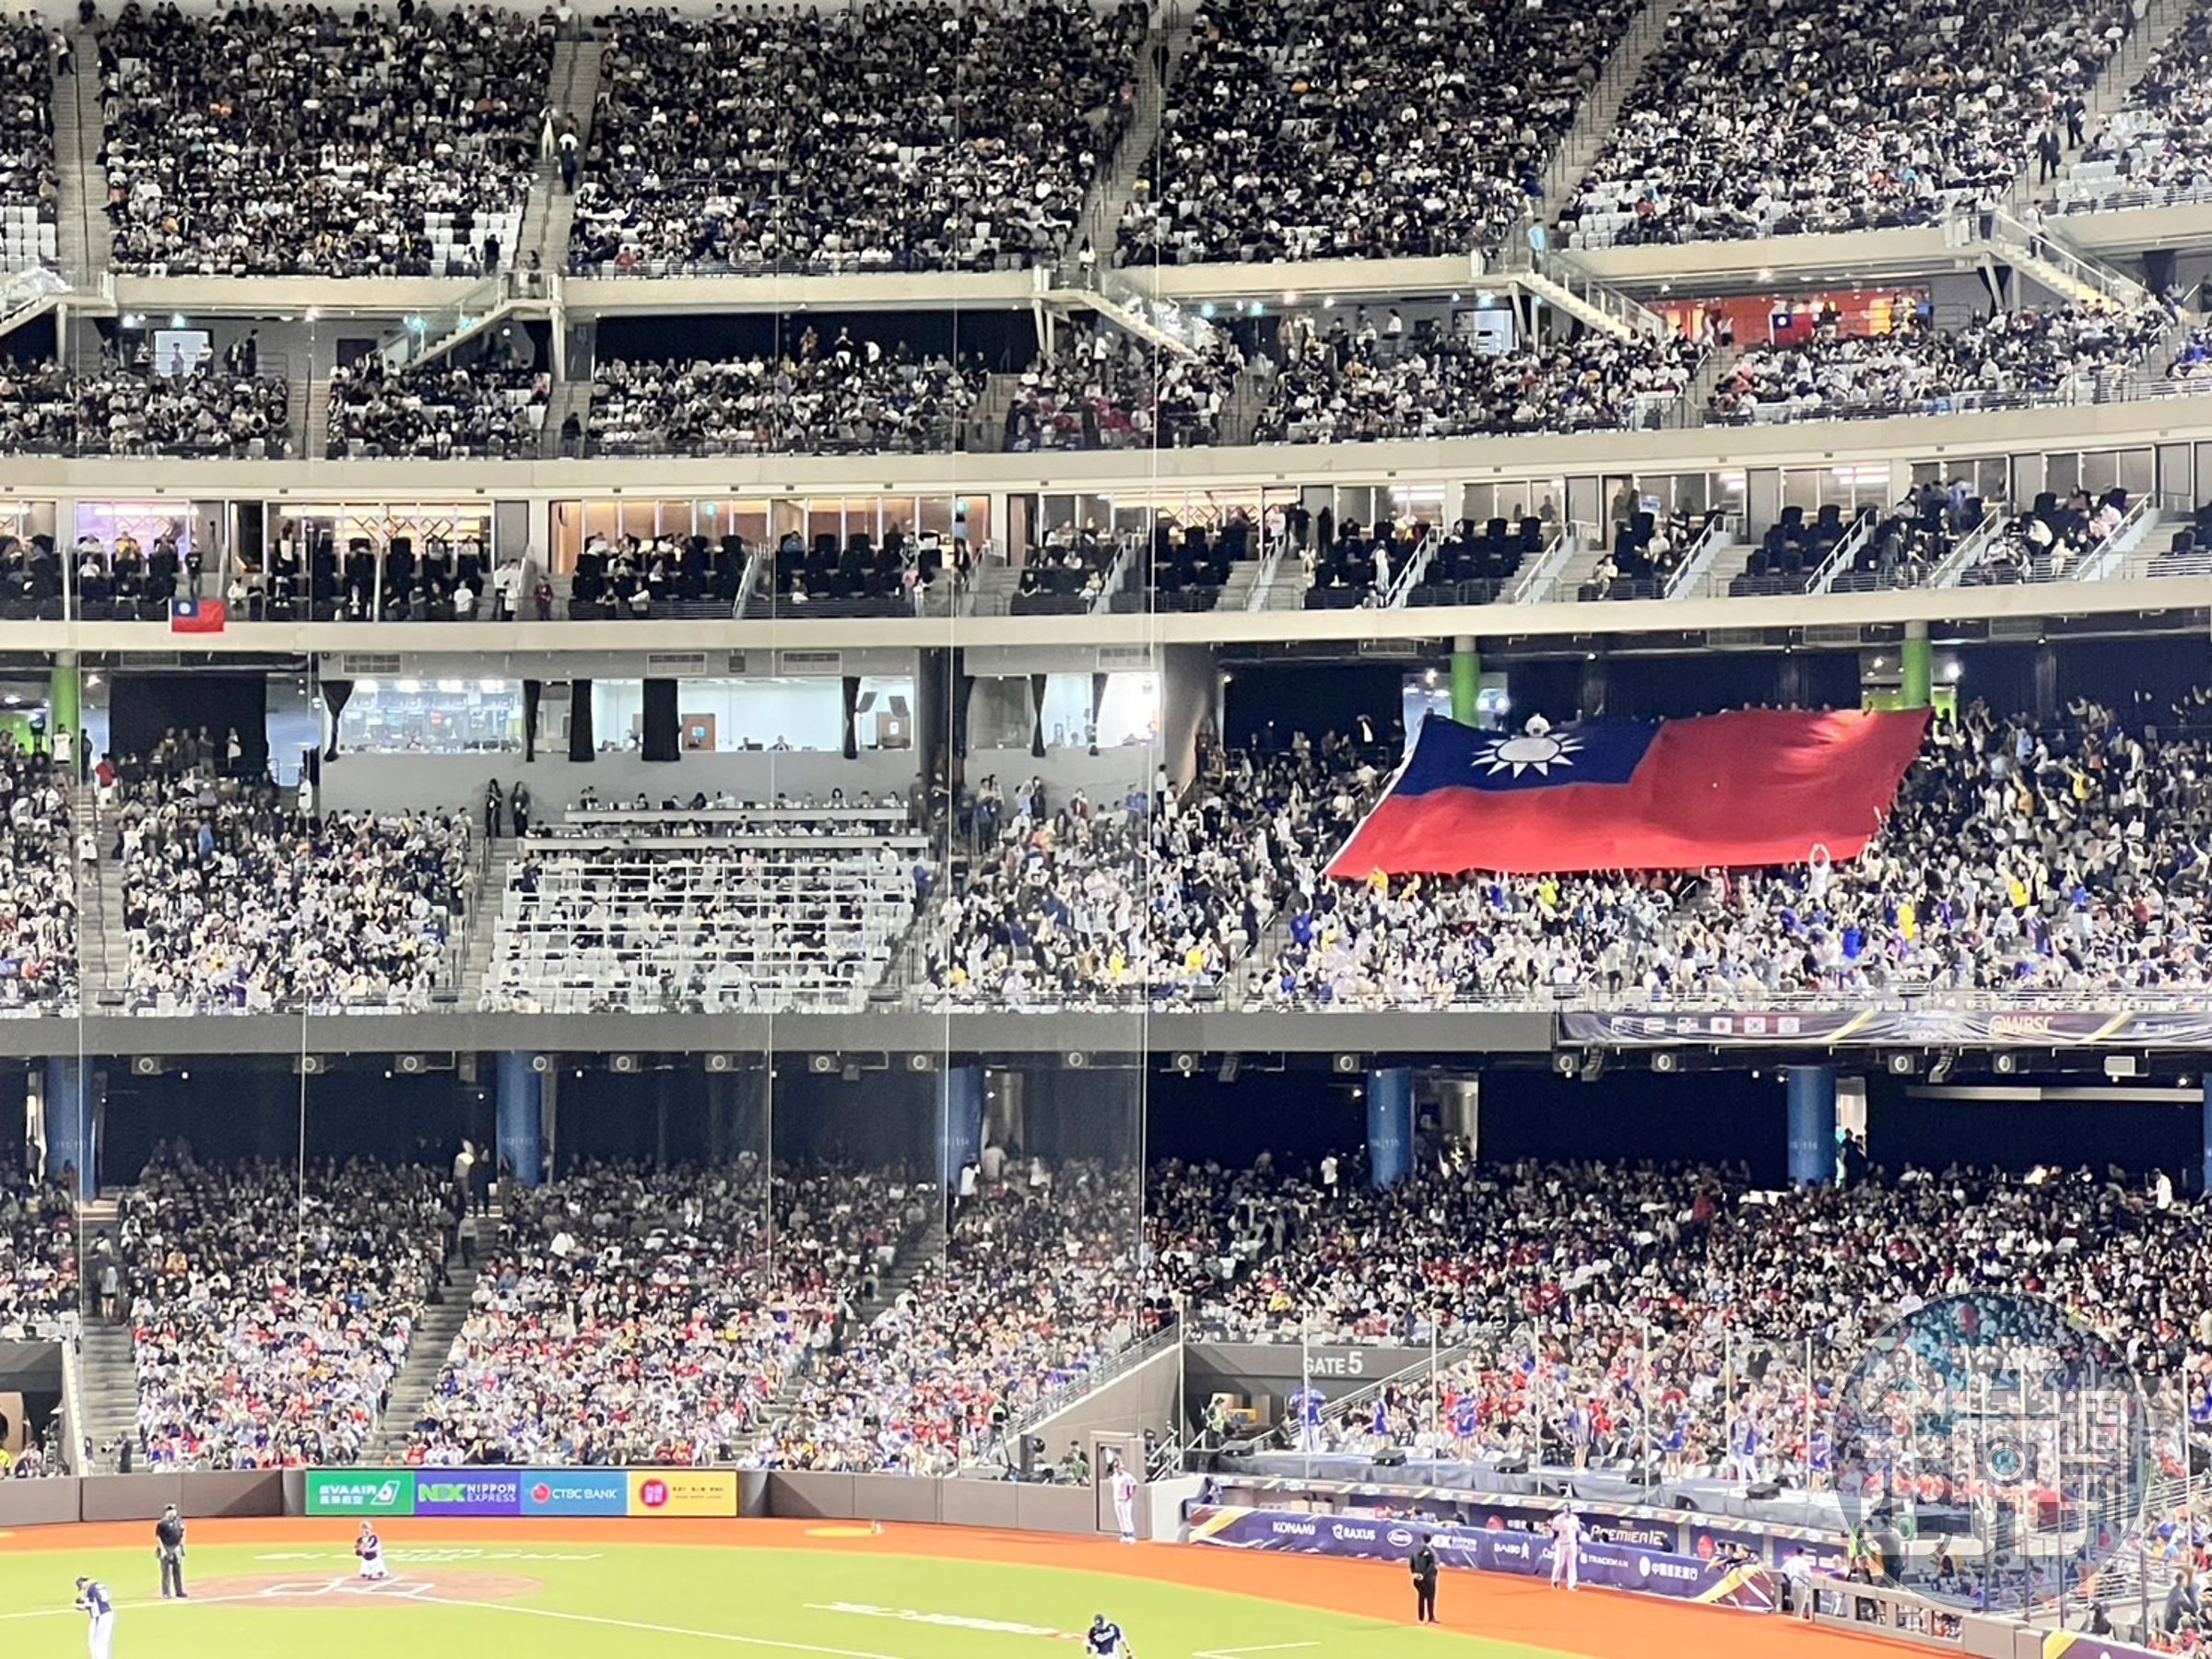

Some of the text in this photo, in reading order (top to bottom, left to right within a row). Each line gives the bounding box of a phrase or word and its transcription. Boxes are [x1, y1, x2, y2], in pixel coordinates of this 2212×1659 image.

[1305, 1350, 1363, 1375] GATE 5
[466, 1484, 516, 1493] NIPPON
[552, 1488, 617, 1500] CTBC BANK
[466, 1493, 516, 1502] EXPRESS
[1272, 1521, 1315, 1535] KONAMI
